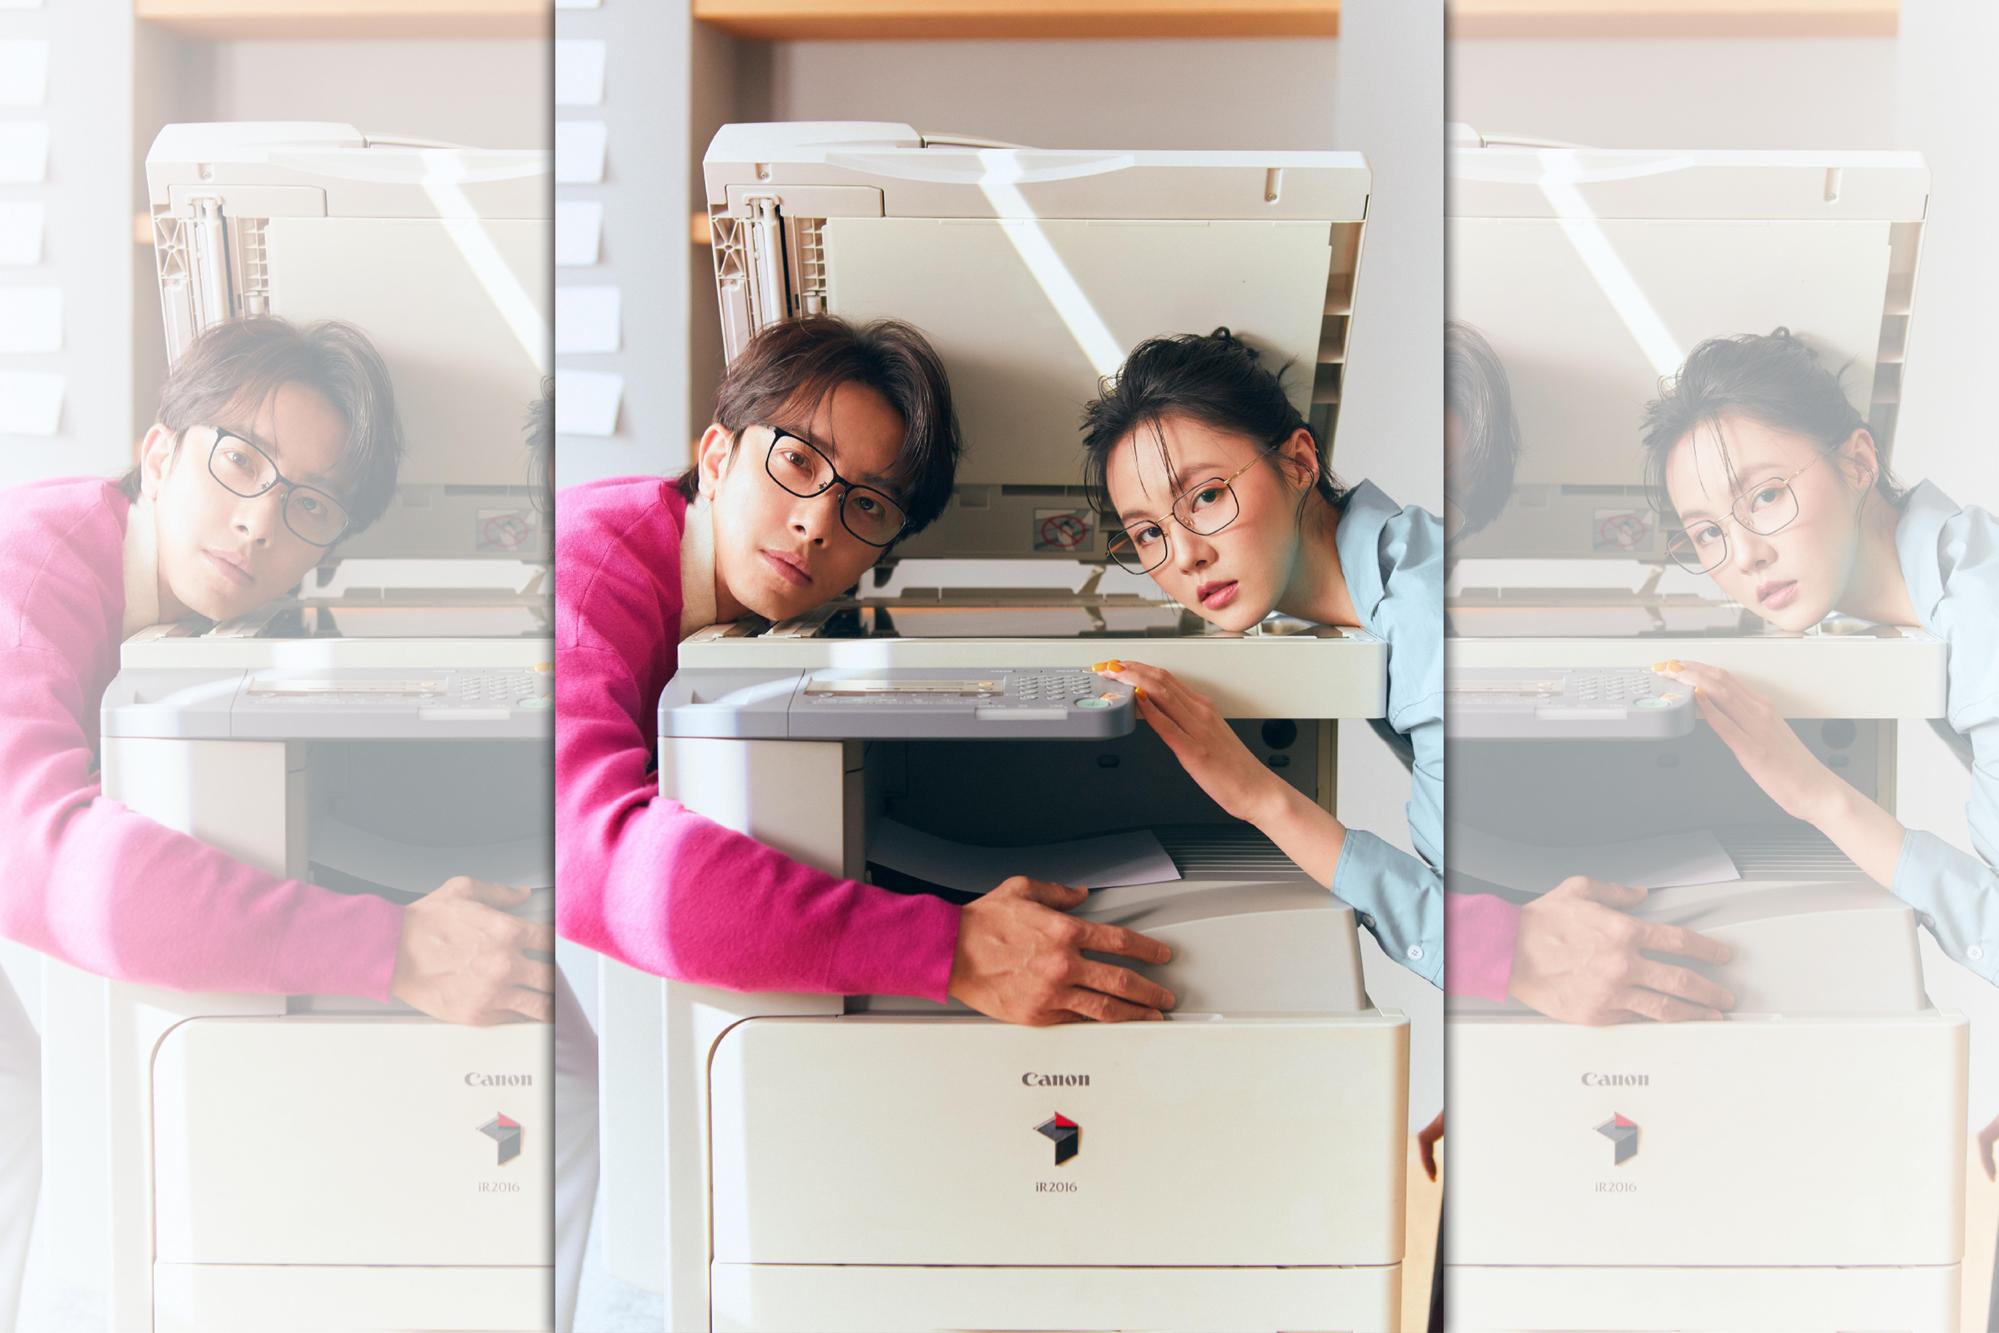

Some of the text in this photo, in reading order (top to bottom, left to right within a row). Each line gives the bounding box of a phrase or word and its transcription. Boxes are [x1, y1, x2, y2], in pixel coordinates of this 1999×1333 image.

[464, 1072, 532, 1087] Canon
[1022, 1072, 1090, 1087] Canon
[1581, 1072, 1650, 1087] Canon
[1036, 1181, 1078, 1193] iR2016
